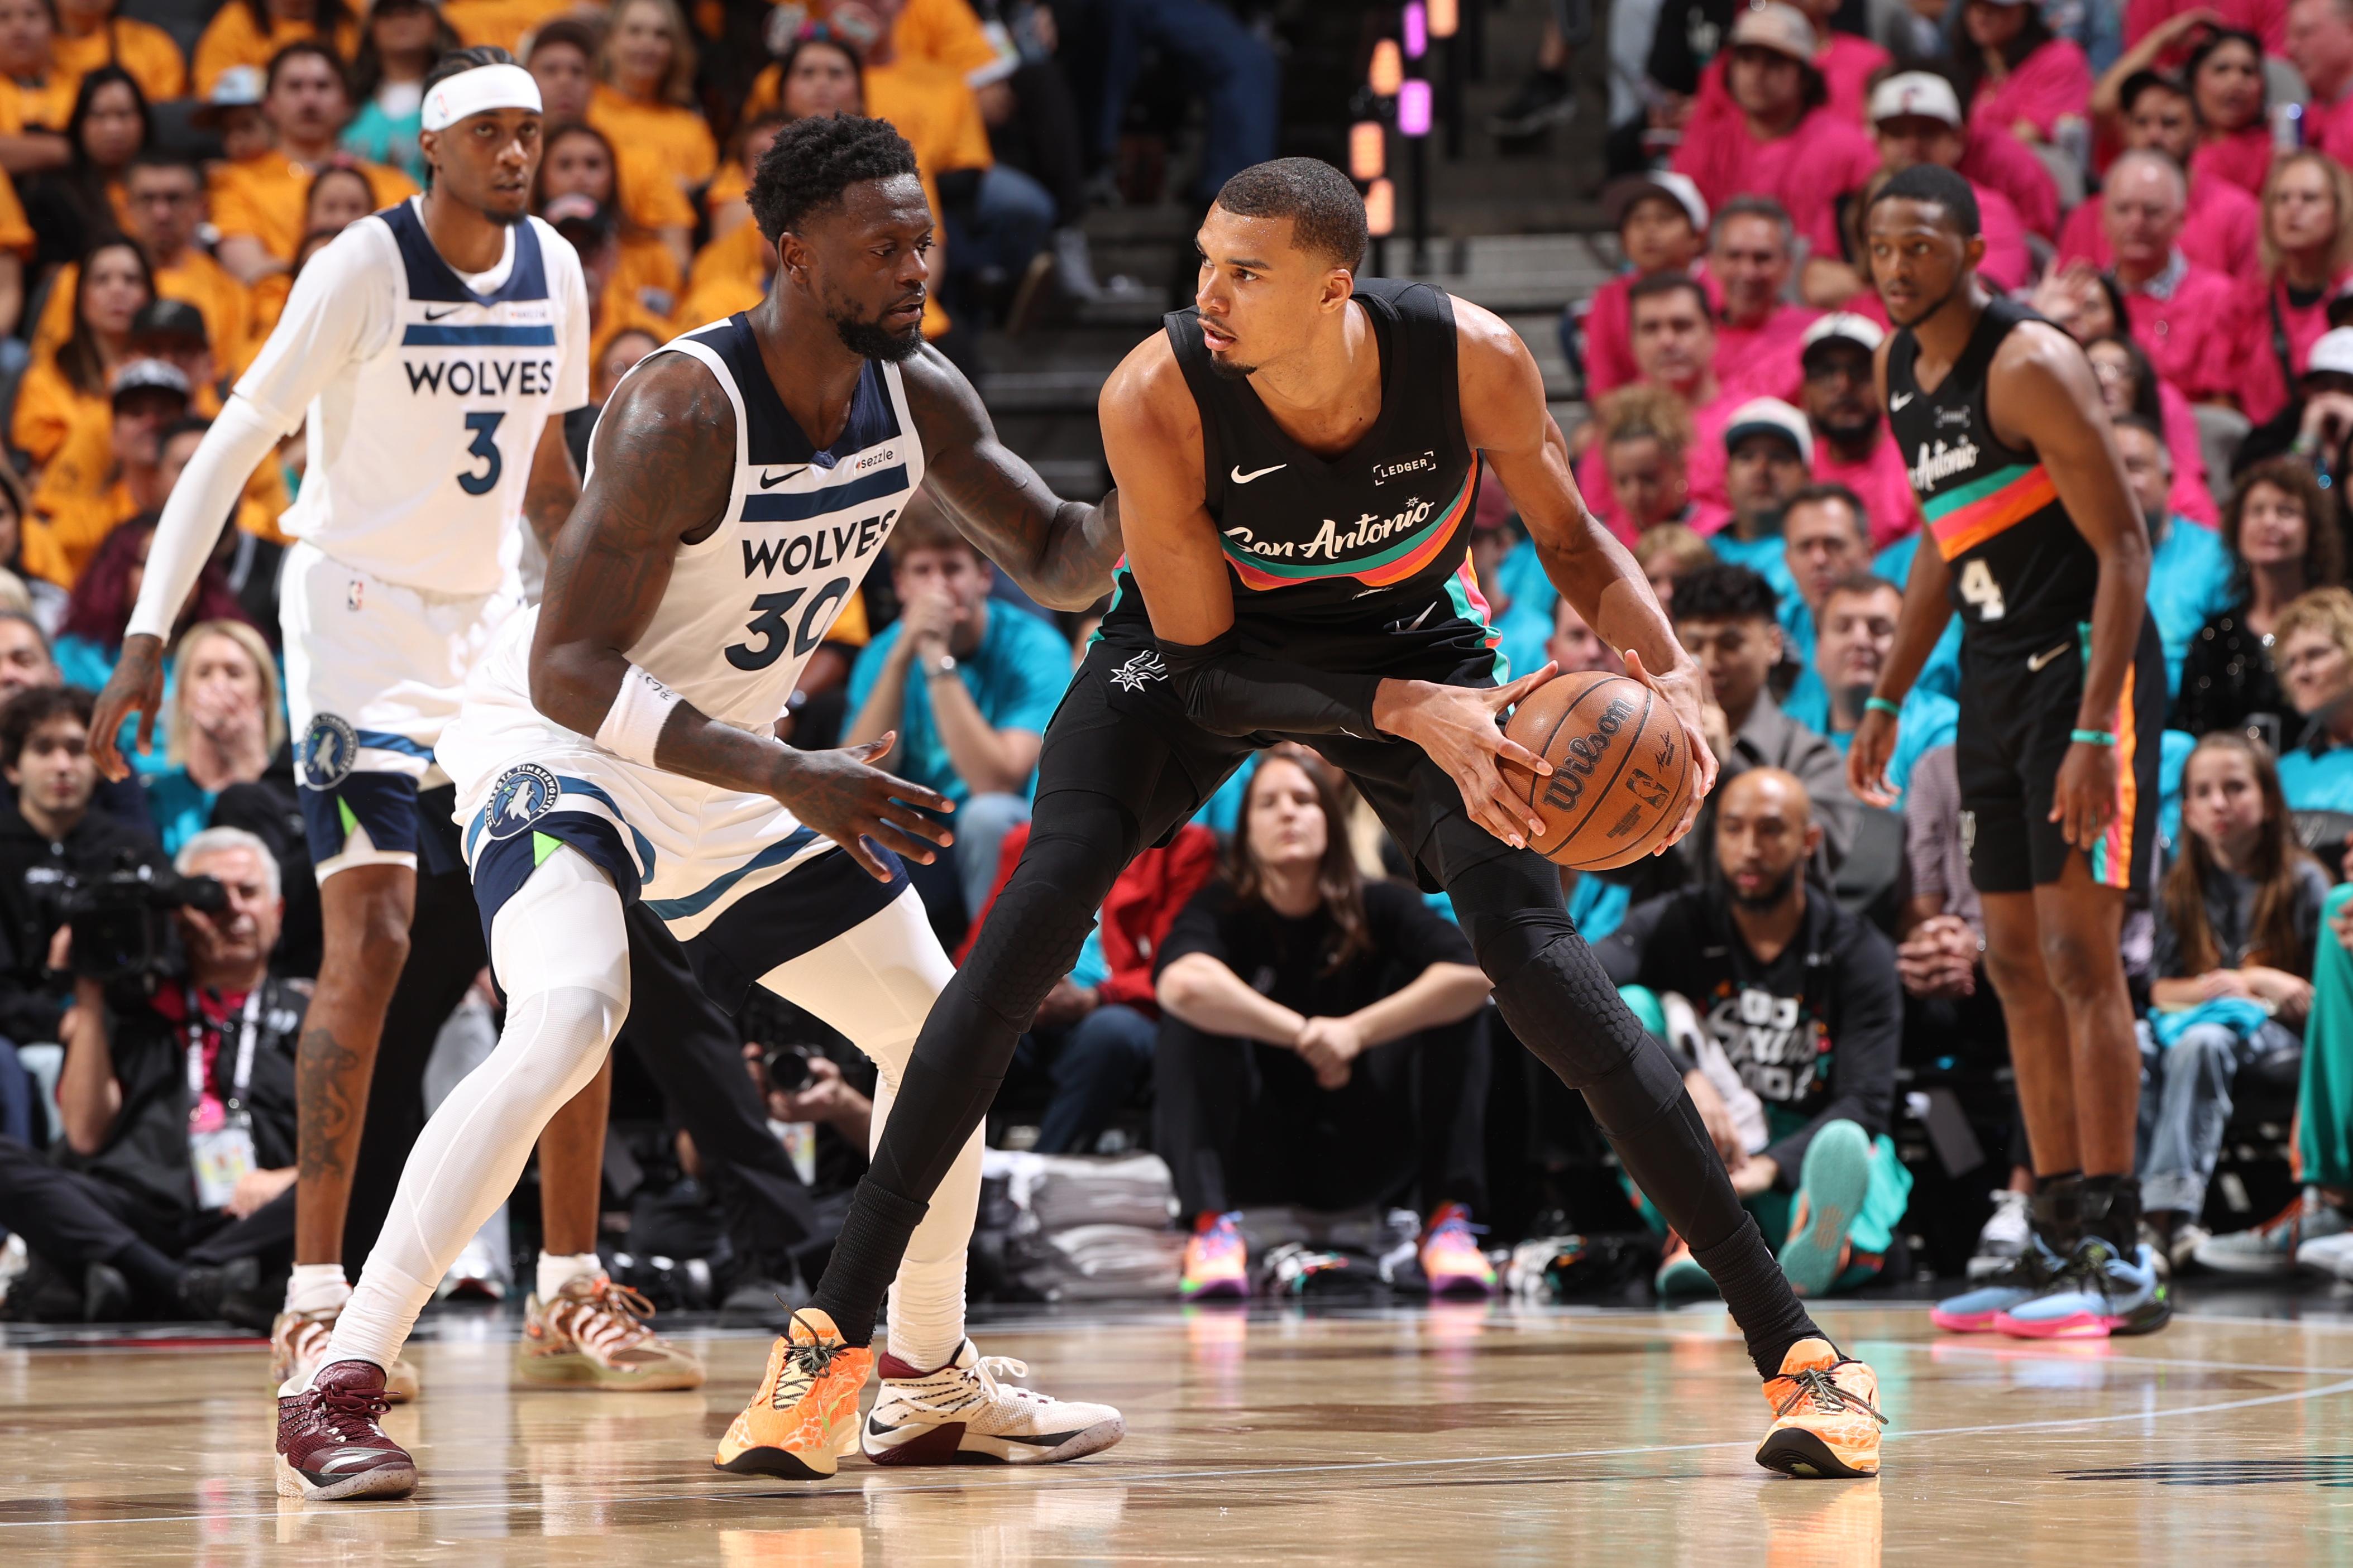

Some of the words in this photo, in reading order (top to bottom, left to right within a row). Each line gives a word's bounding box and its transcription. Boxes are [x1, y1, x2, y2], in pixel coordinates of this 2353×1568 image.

[404, 360, 552, 396] WOLVES
[457, 412, 507, 496] 3
[861, 449, 893, 469] sezzle
[1381, 458, 1427, 478] LEDGER
[742, 509, 897, 579] WOLVES
[1223, 526, 1294, 557] San
[1298, 496, 1434, 559] Antonio
[1958, 557, 2006, 622] 4
[1541, 698, 1636, 812] Wilson
